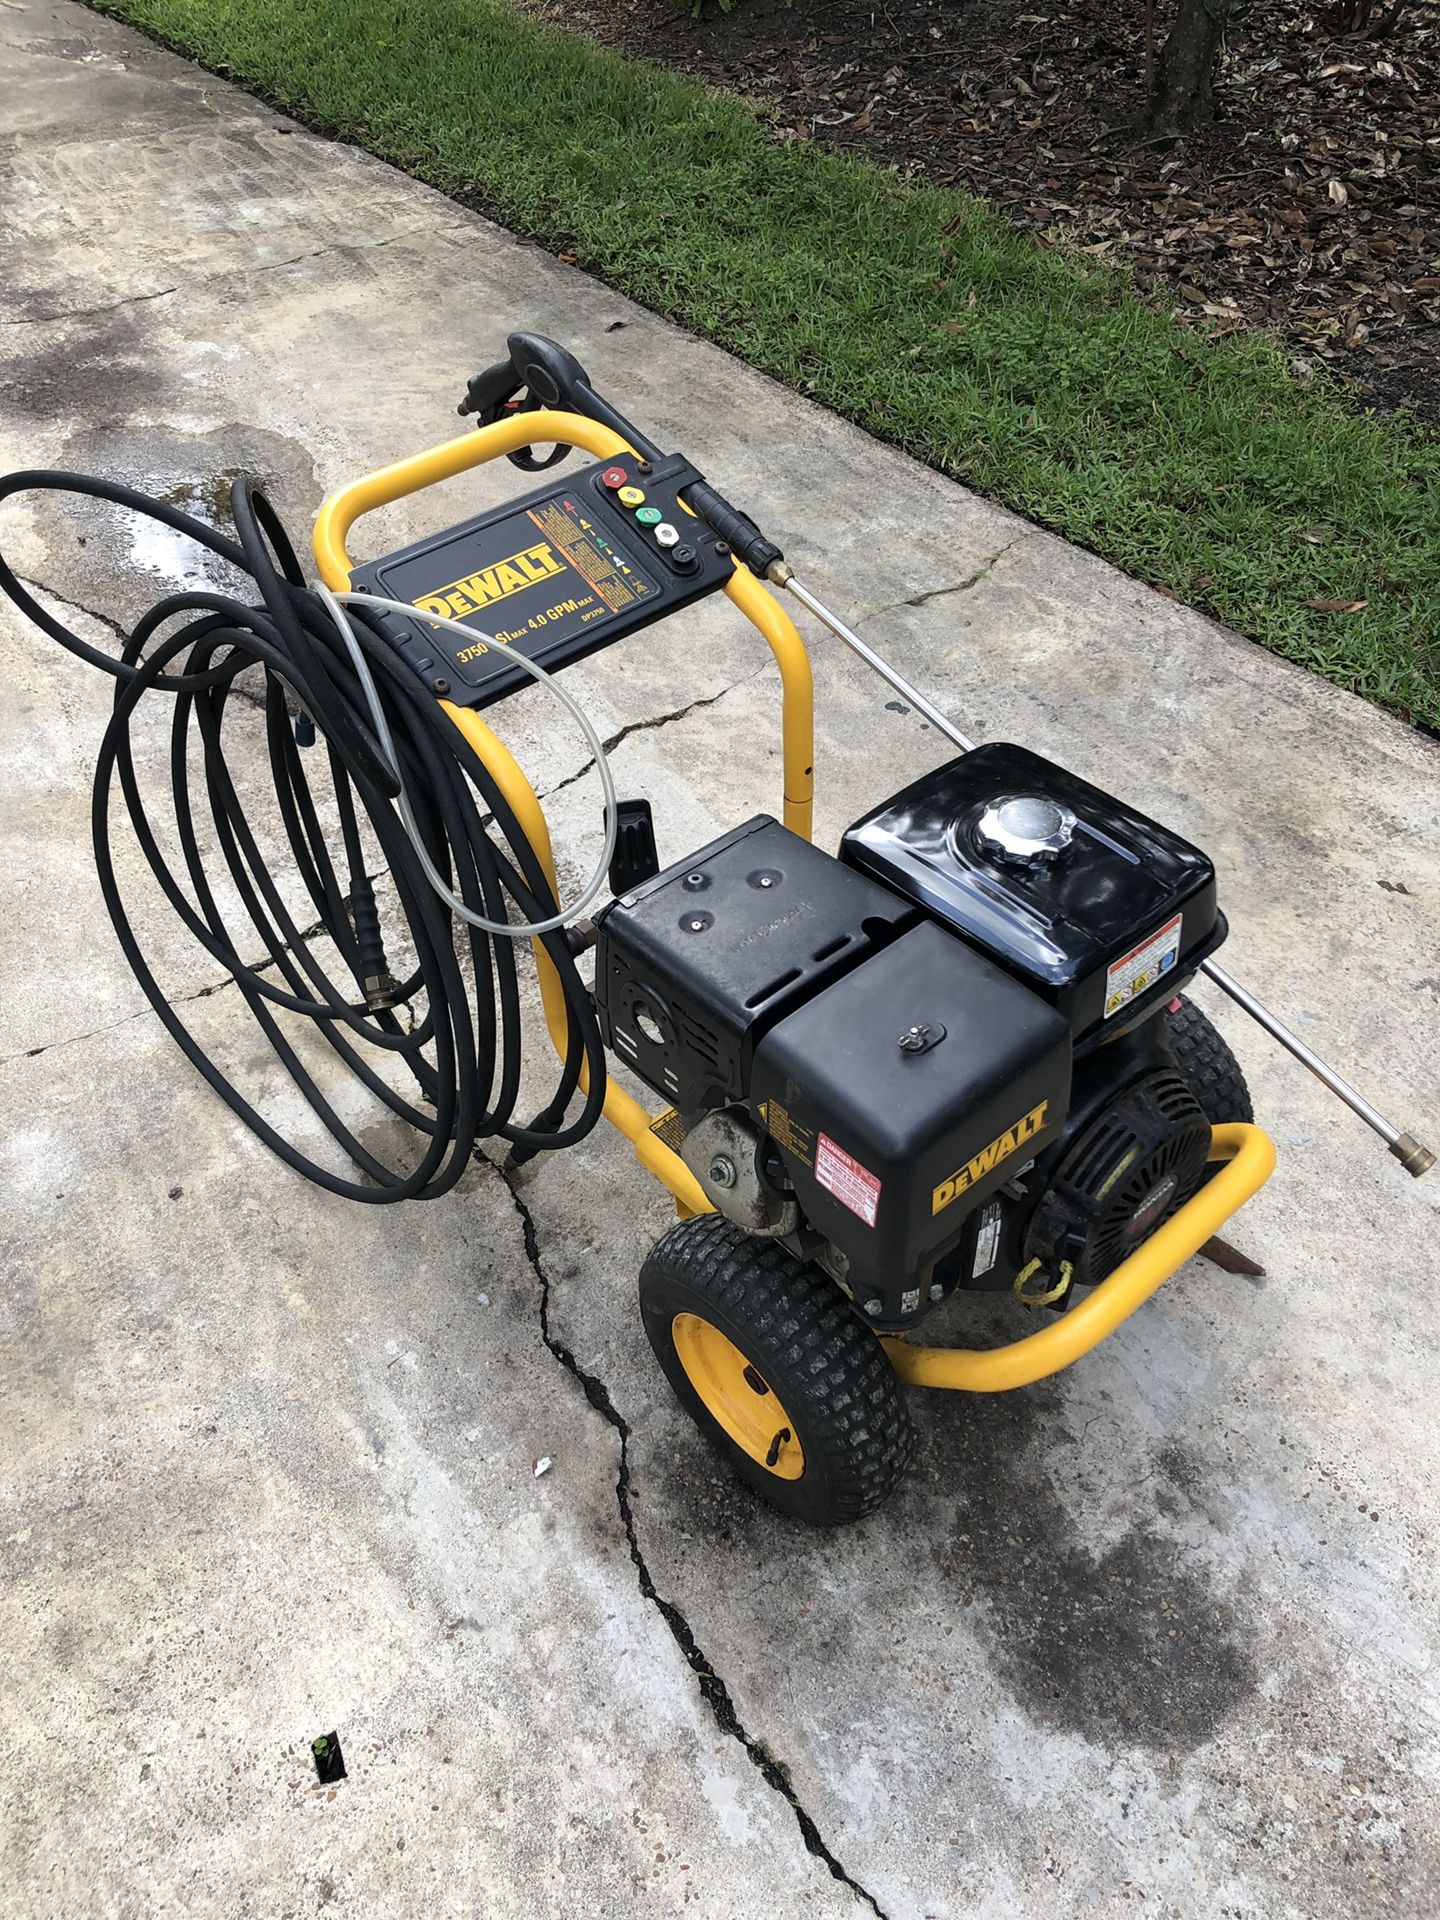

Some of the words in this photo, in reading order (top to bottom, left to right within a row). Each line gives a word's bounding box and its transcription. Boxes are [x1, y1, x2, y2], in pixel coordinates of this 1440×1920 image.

[456, 642, 489, 664] 3750
[511, 627, 529, 640] MAX
[527, 614, 548, 630] 4.0
[546, 599, 579, 621] GPM
[577, 595, 594, 608] MAX
